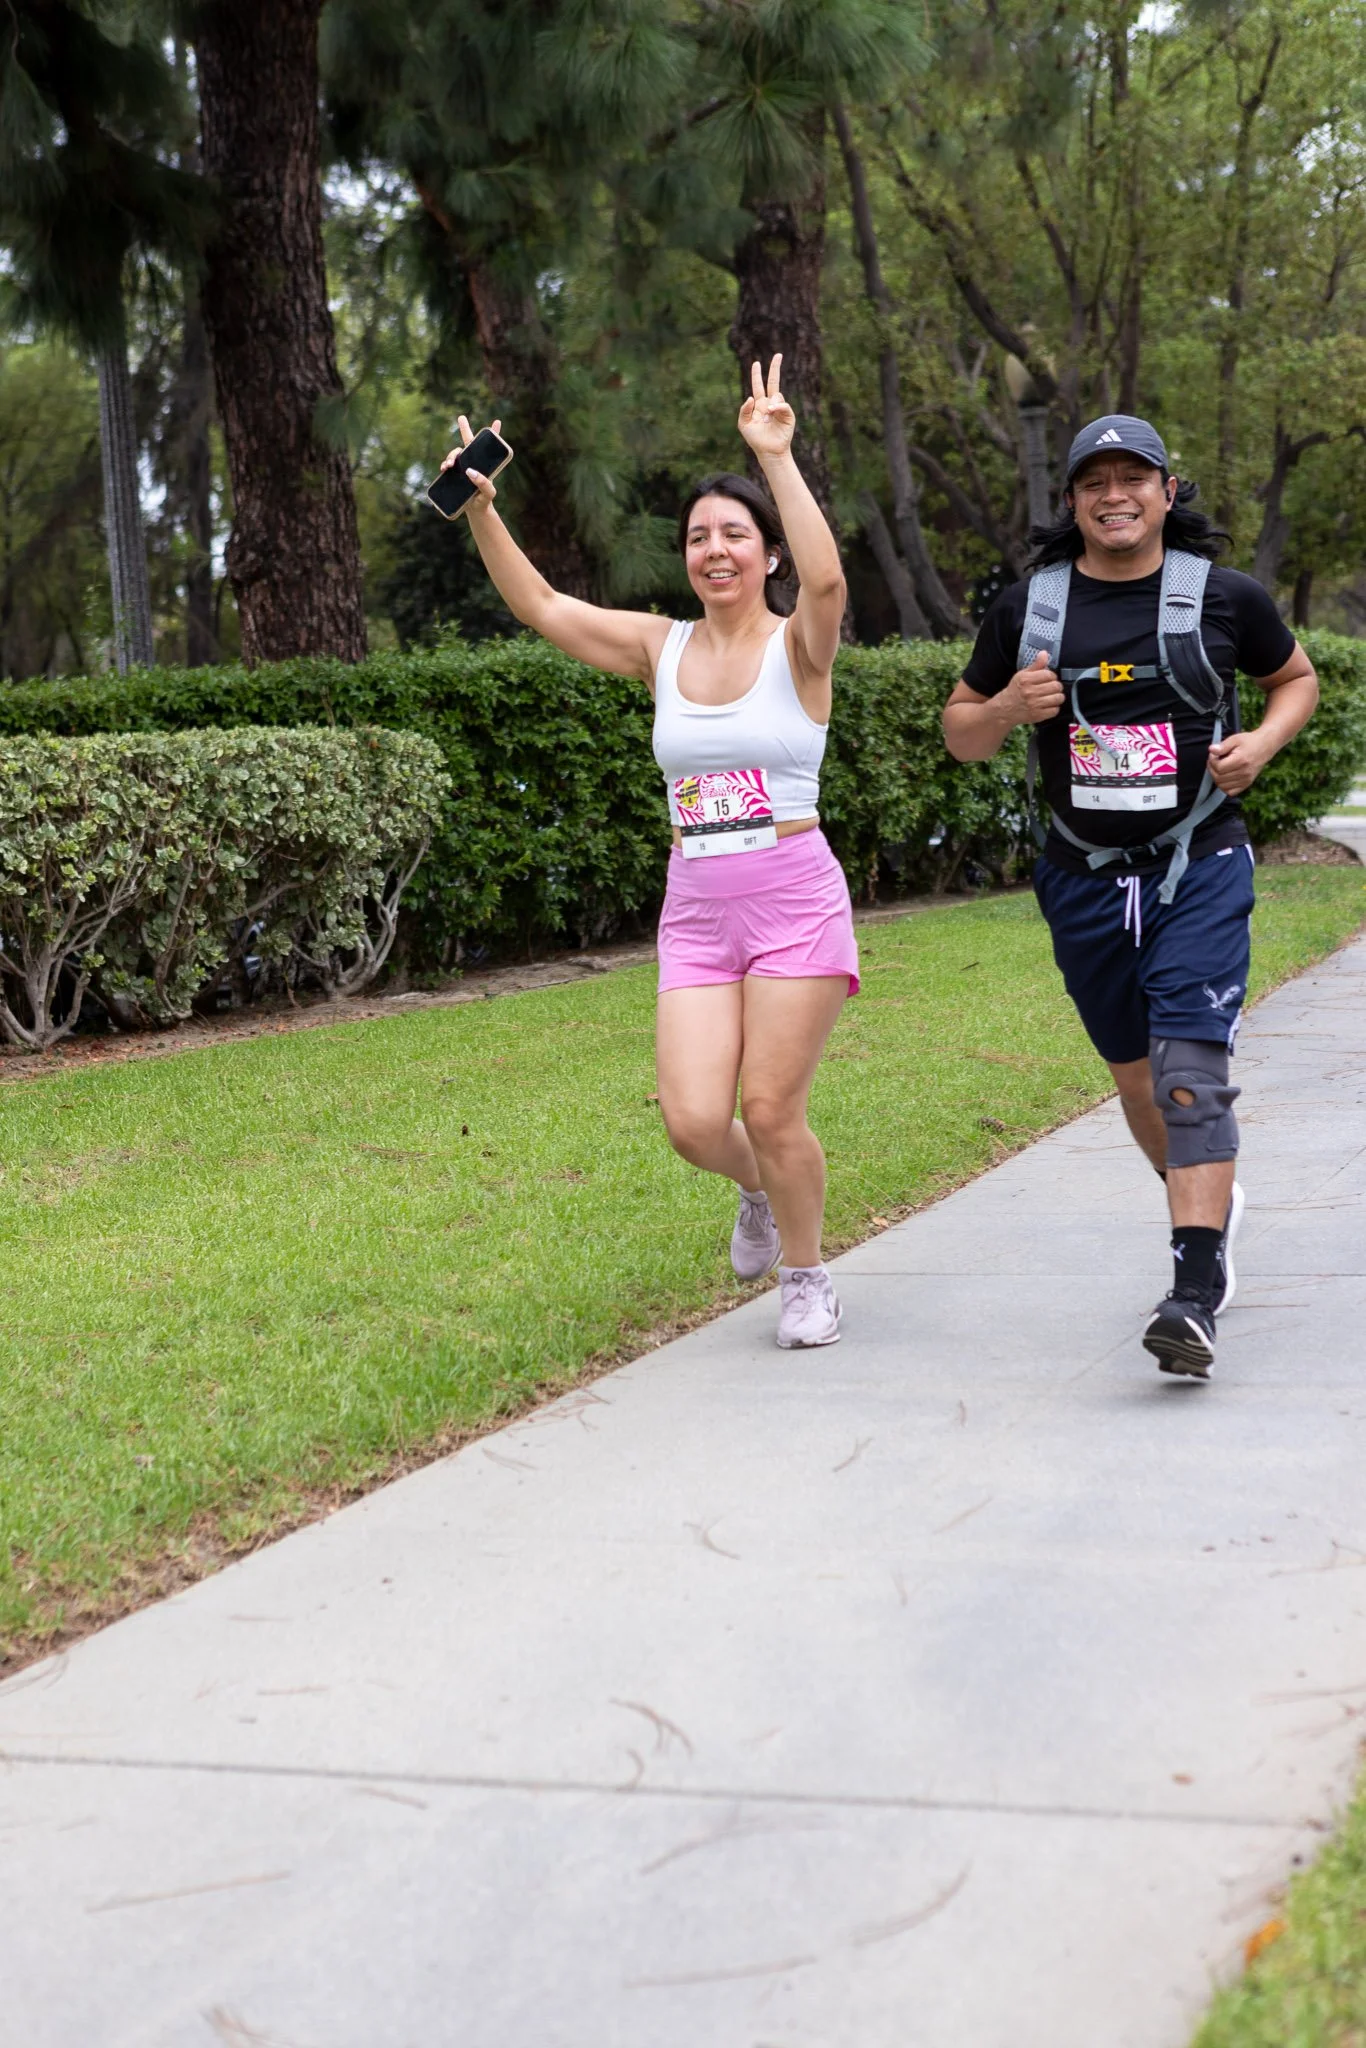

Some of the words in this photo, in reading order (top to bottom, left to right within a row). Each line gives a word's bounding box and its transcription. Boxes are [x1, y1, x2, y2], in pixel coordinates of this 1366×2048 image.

[1114, 753, 1130, 770] 14
[714, 798, 730, 817] 15
[699, 842, 706, 851] 15
